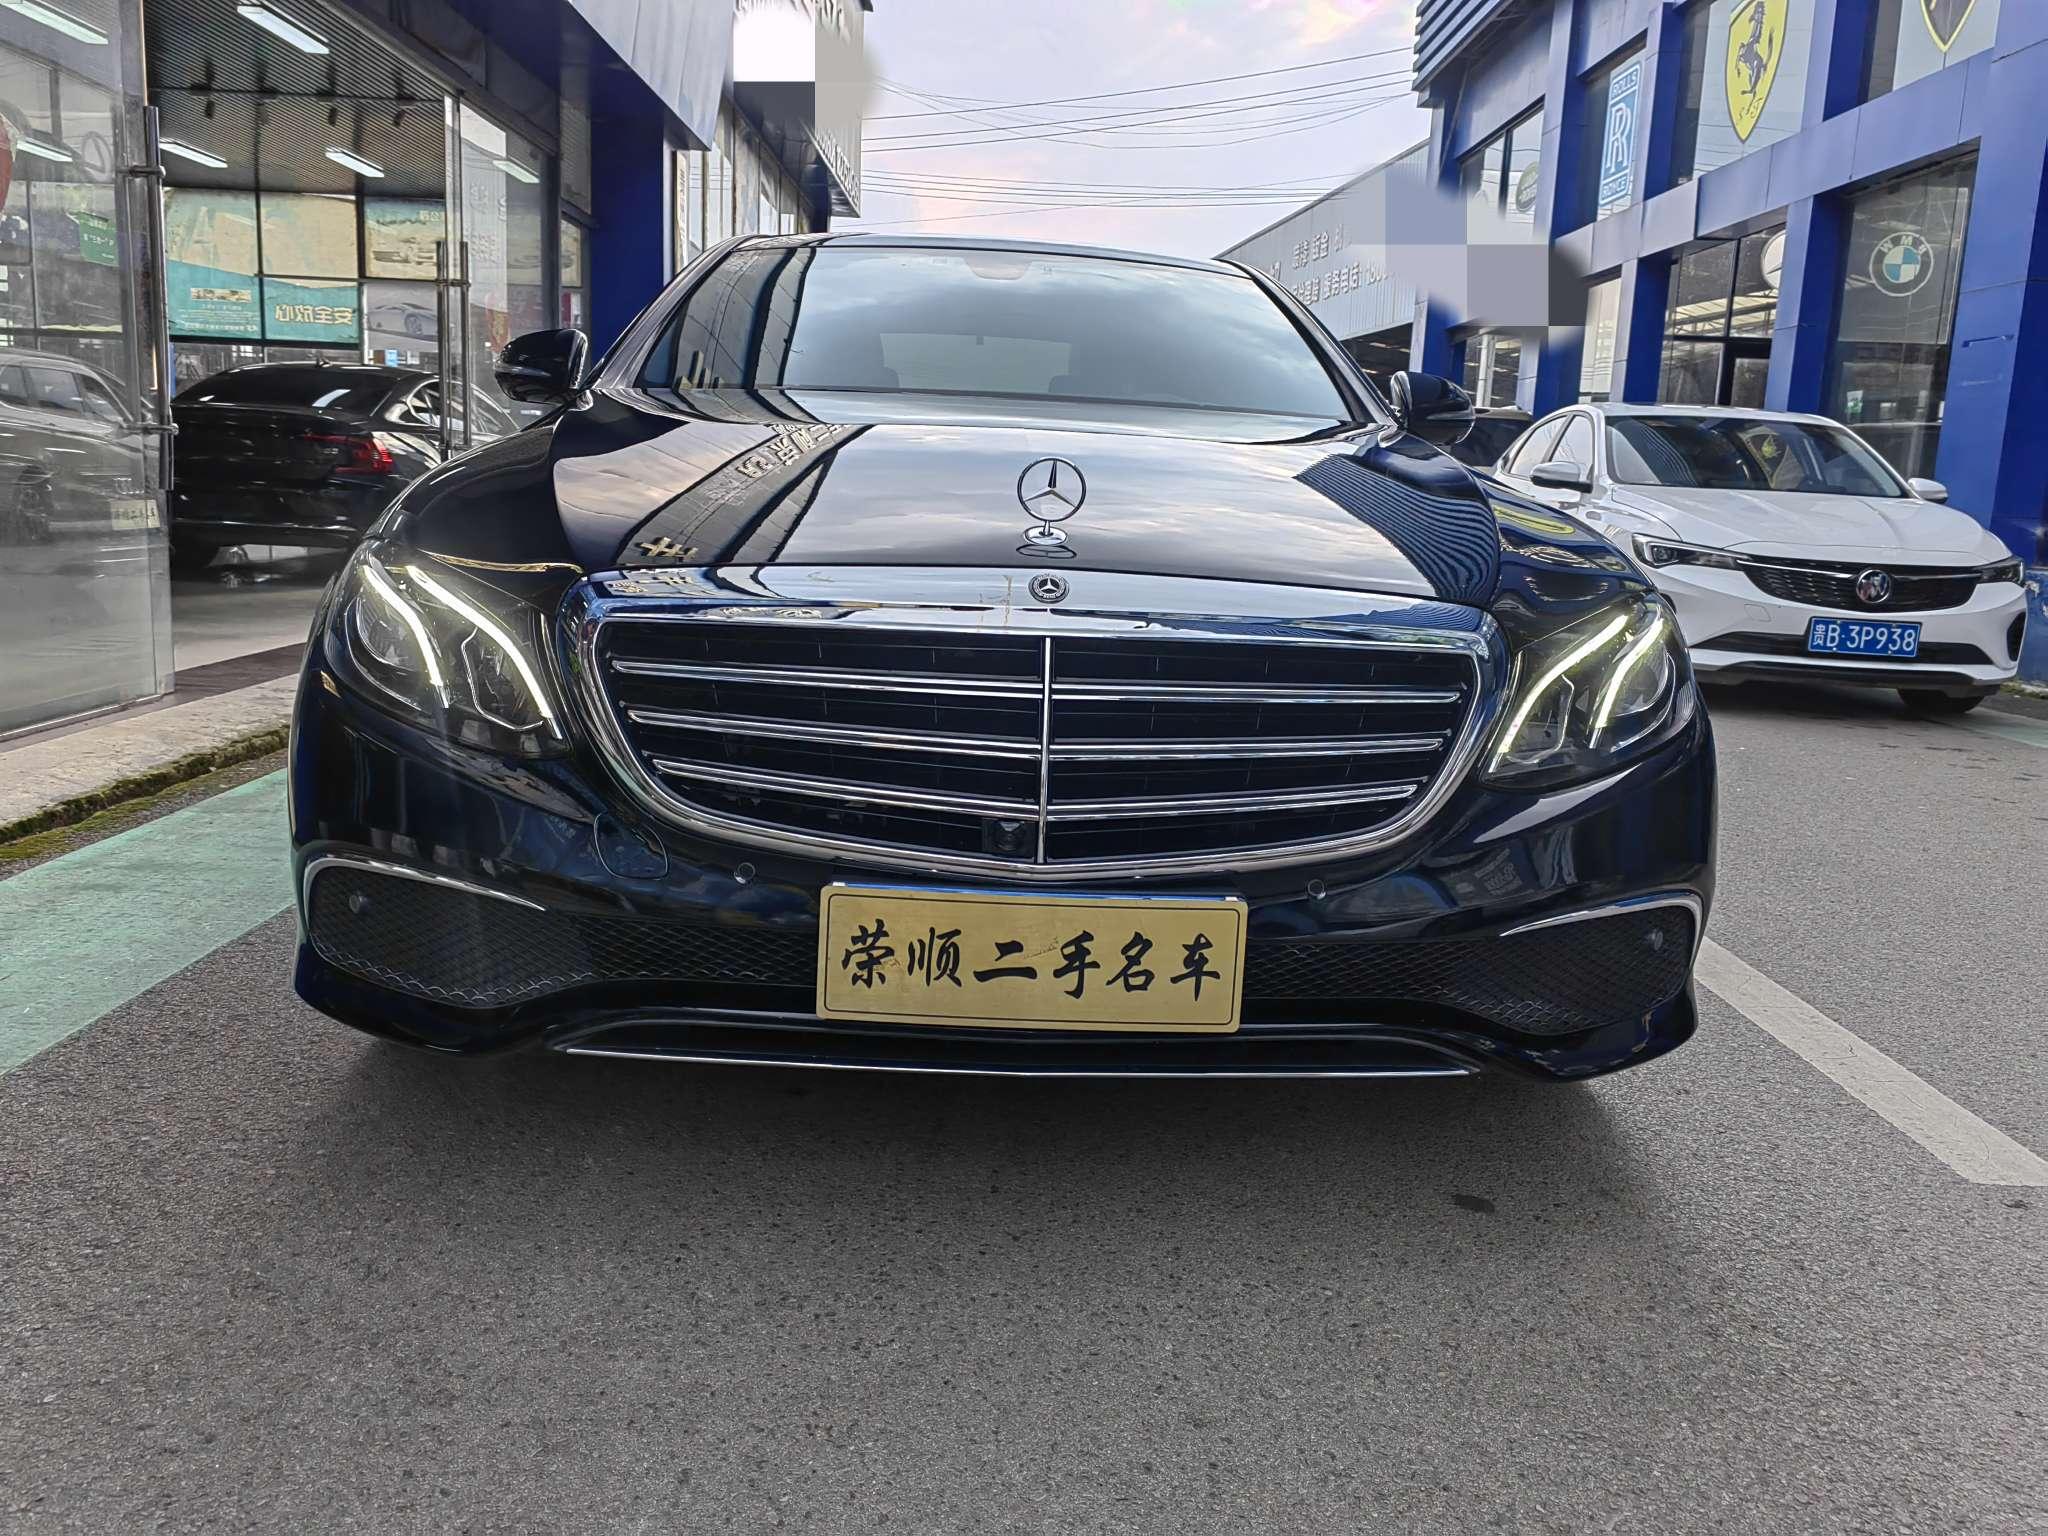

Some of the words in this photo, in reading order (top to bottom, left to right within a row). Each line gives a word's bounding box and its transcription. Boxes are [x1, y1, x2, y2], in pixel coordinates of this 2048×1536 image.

[841, 918, 1221, 1001] 荣顺二手名车
